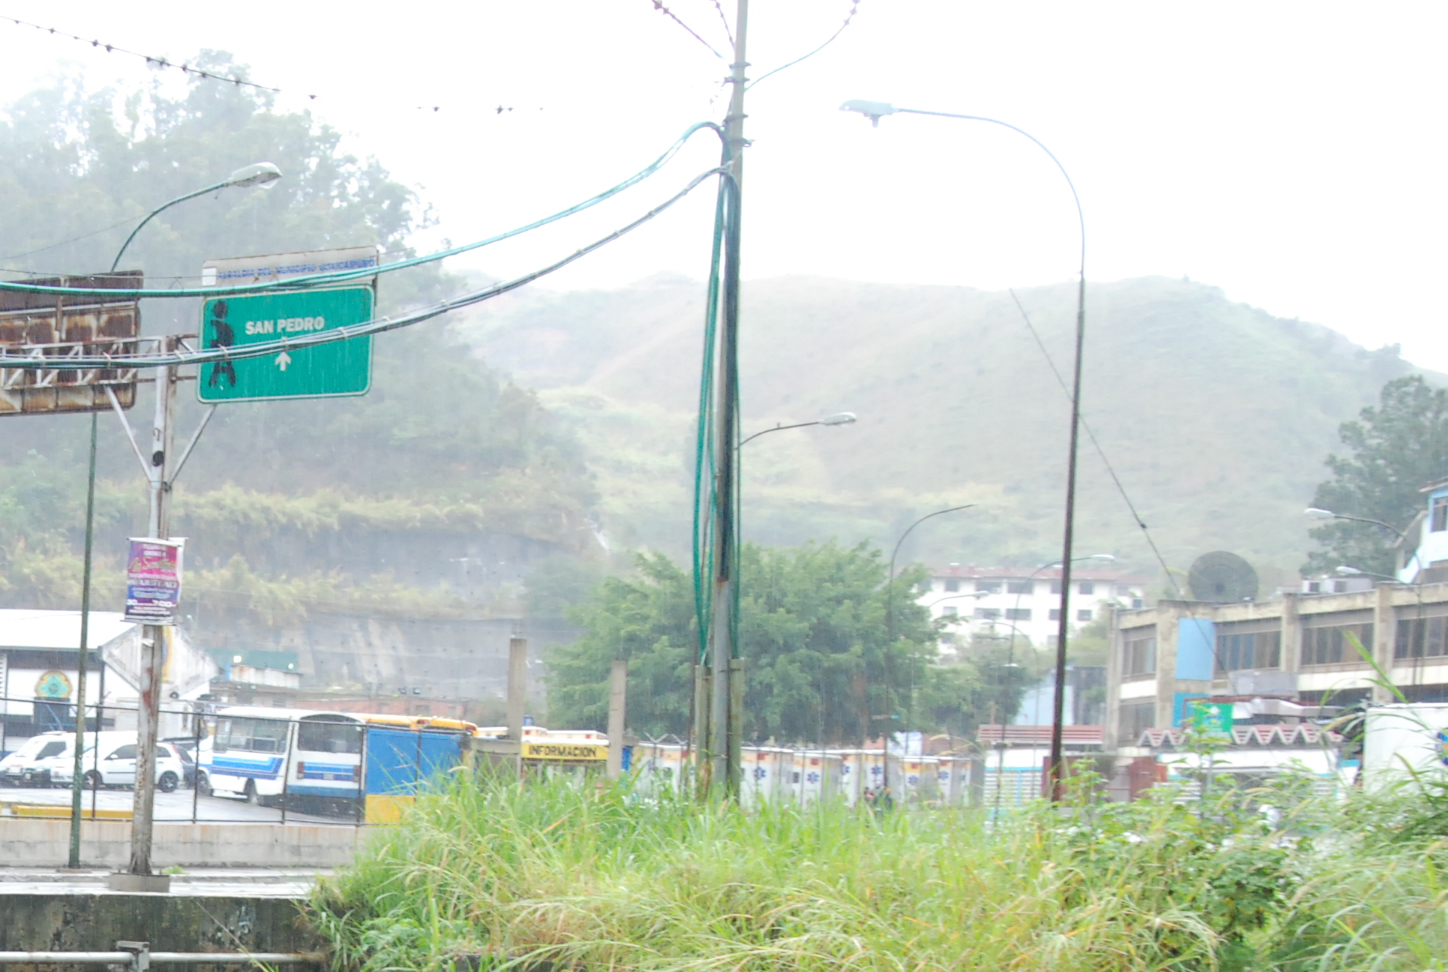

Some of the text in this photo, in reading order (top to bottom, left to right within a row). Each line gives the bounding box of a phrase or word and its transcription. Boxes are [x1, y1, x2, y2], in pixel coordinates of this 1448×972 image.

[245, 316, 325, 335] SAN PEDRO
[529, 745, 596, 757] INFORMACION
